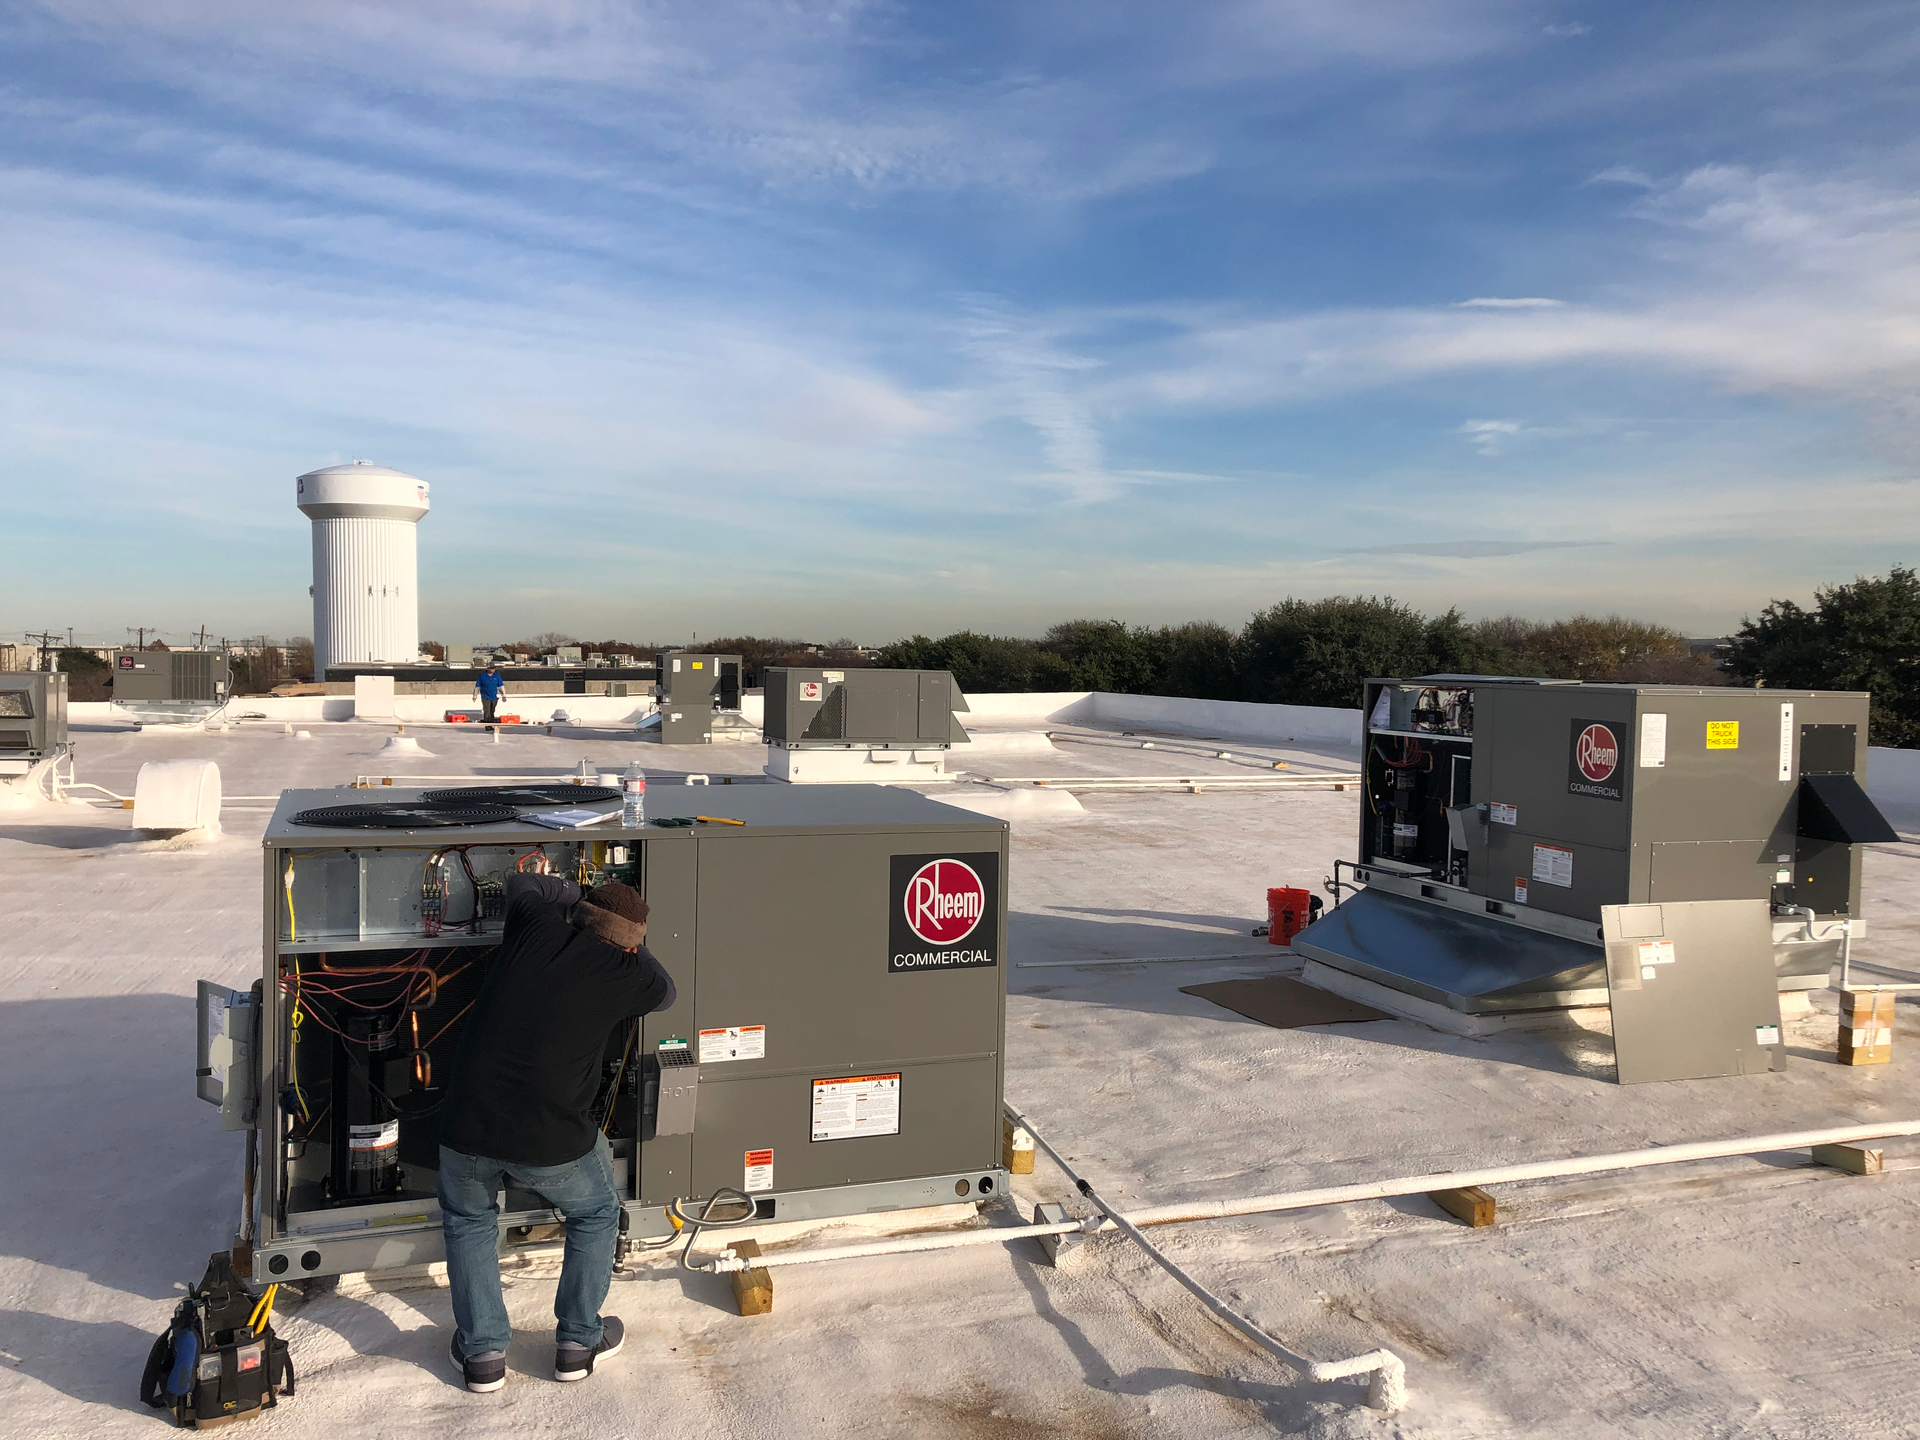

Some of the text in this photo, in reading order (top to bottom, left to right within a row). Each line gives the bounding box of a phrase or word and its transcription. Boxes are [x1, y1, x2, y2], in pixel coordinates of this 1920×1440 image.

[1710, 722, 1734, 730] DO NOT
[1581, 727, 1615, 772] Rheem
[1707, 738, 1721, 746] THIS
[1570, 782, 1620, 798] COMMERCIAL
[915, 863, 978, 931] Rheem
[894, 949, 992, 967] COMMERCIAL
[660, 1085, 695, 1099] HOT
